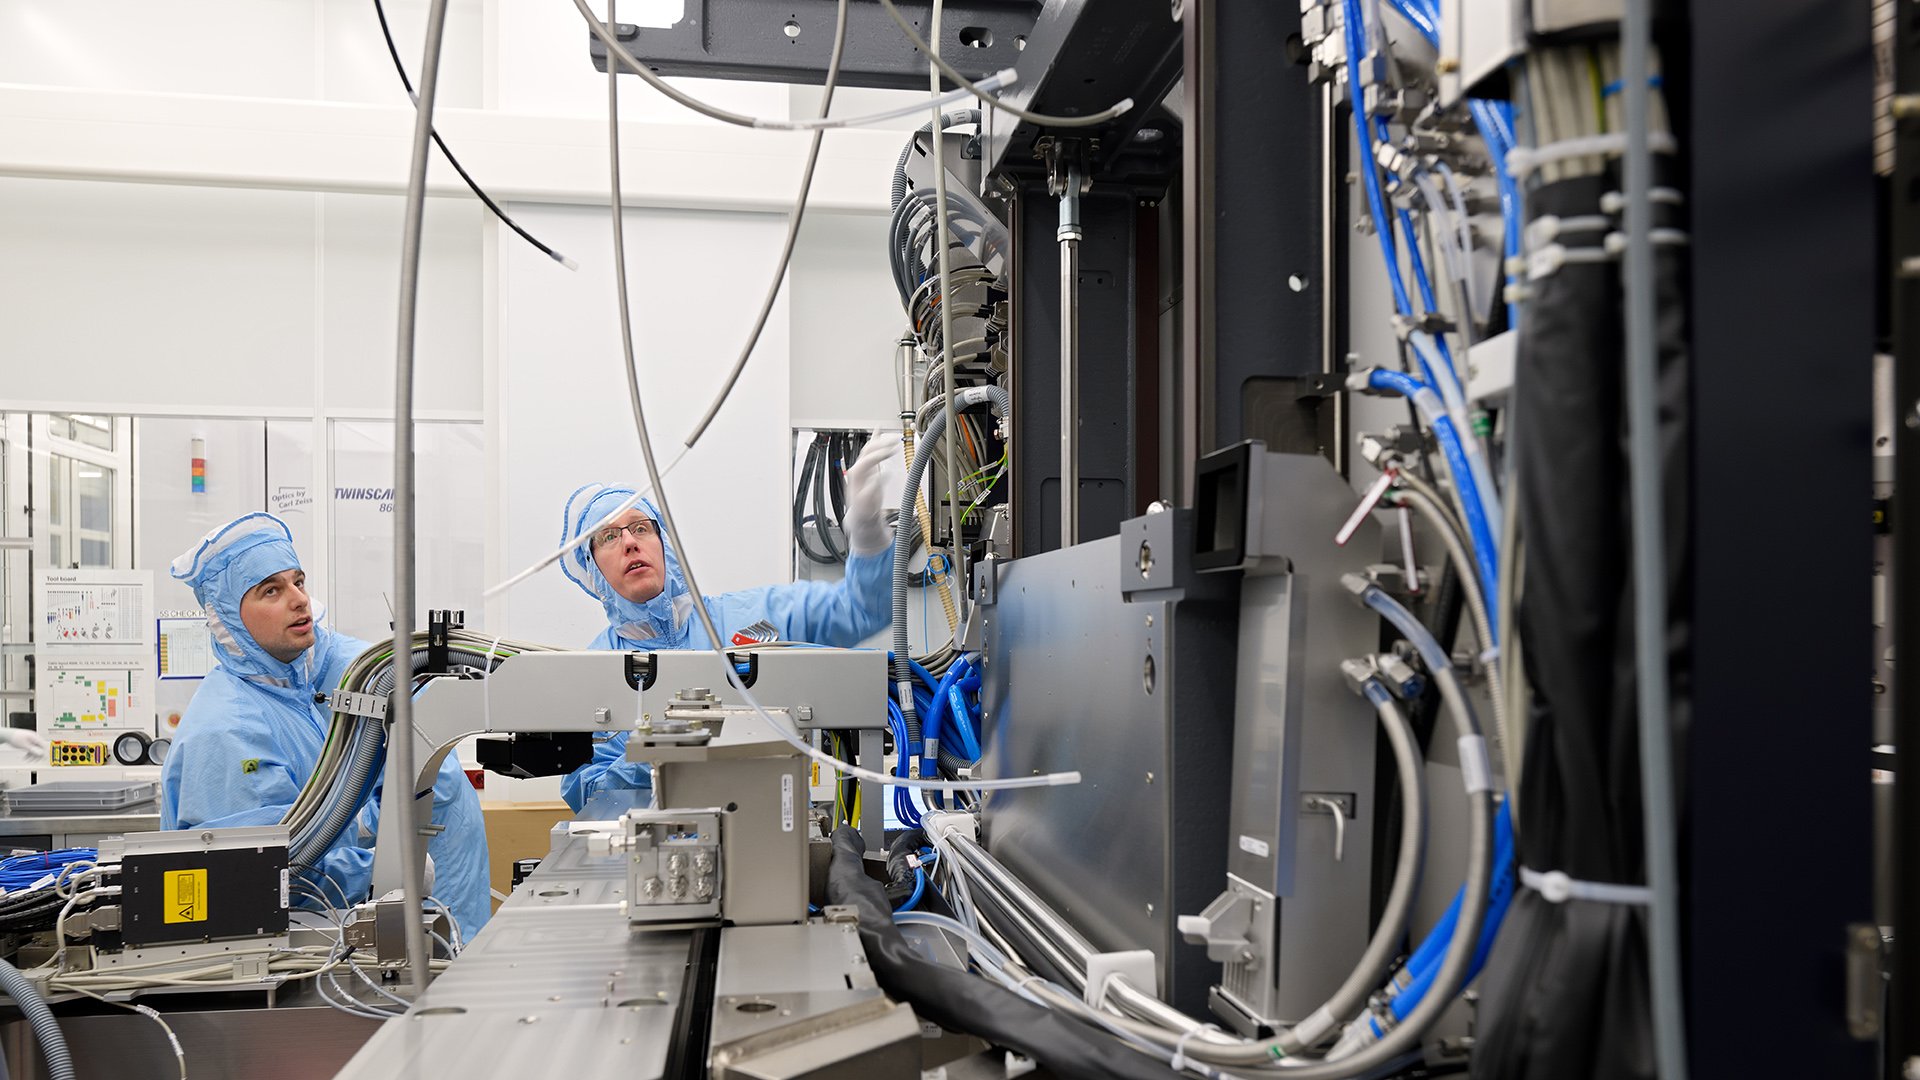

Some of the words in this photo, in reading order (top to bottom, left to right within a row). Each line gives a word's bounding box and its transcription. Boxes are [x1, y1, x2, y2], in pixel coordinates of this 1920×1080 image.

[272, 493, 294, 502] Optics
[296, 490, 305, 498] by
[279, 500, 293, 508] Carl
[295, 498, 313, 506] Zeiss
